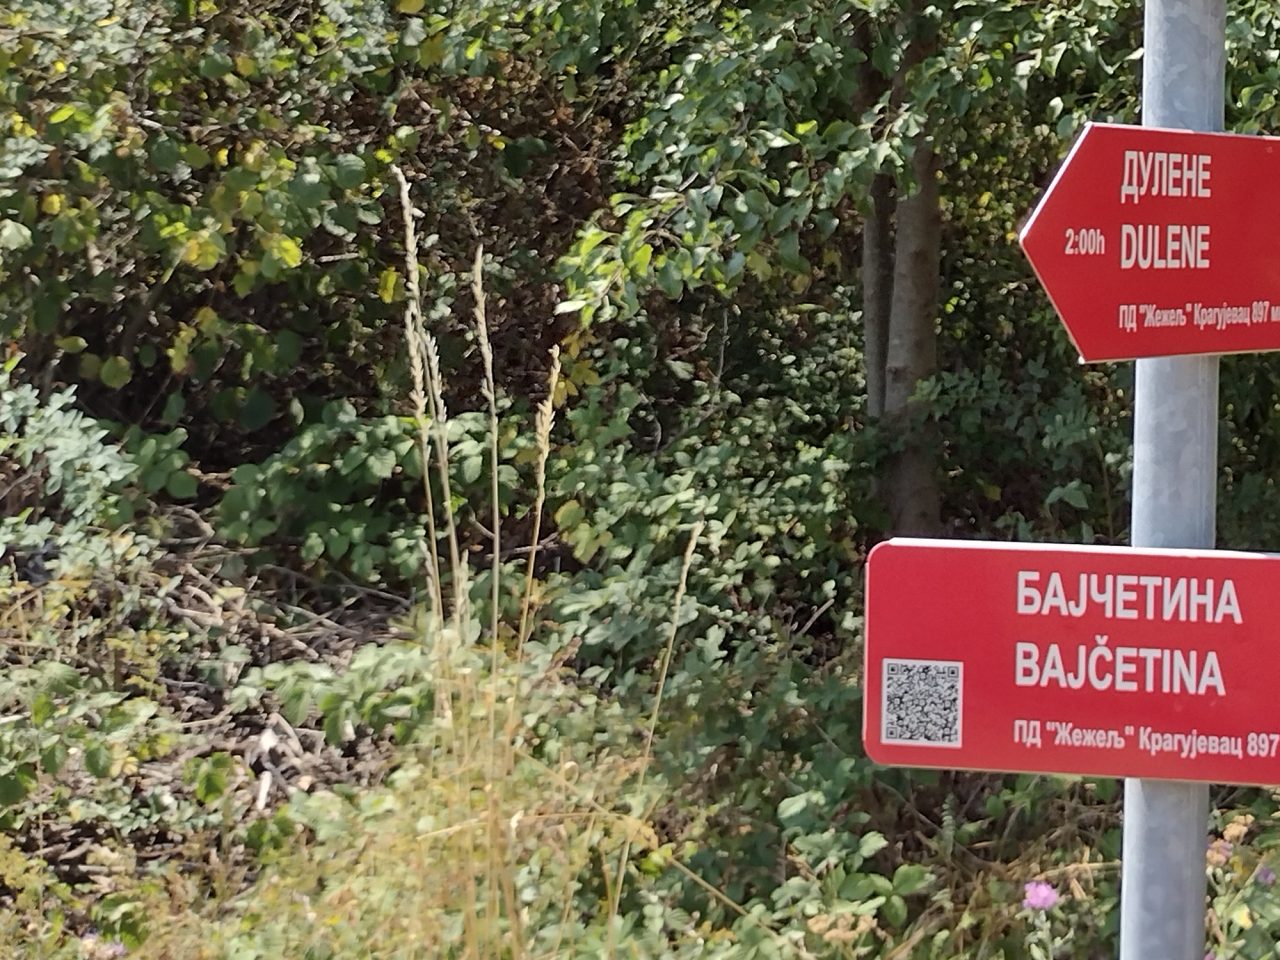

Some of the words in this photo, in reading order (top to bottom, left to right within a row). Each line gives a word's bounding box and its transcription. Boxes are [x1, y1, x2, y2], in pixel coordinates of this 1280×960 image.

[1121, 150, 1212, 204] ДУЛЕНЕ
[1065, 228, 1105, 255] 2:00h
[1121, 224, 1210, 269] DULENE
[1119, 305, 1137, 333] ПД
[1252, 301, 1269, 324] 897
[1017, 571, 1243, 625] БАЈЧЕТИНА
[1015, 635, 1226, 697] BAJČETINA
[1013, 720, 1041, 748] ПД
[1139, 728, 1243, 759] Крагујевац
[1247, 733, 1280, 759] 897
